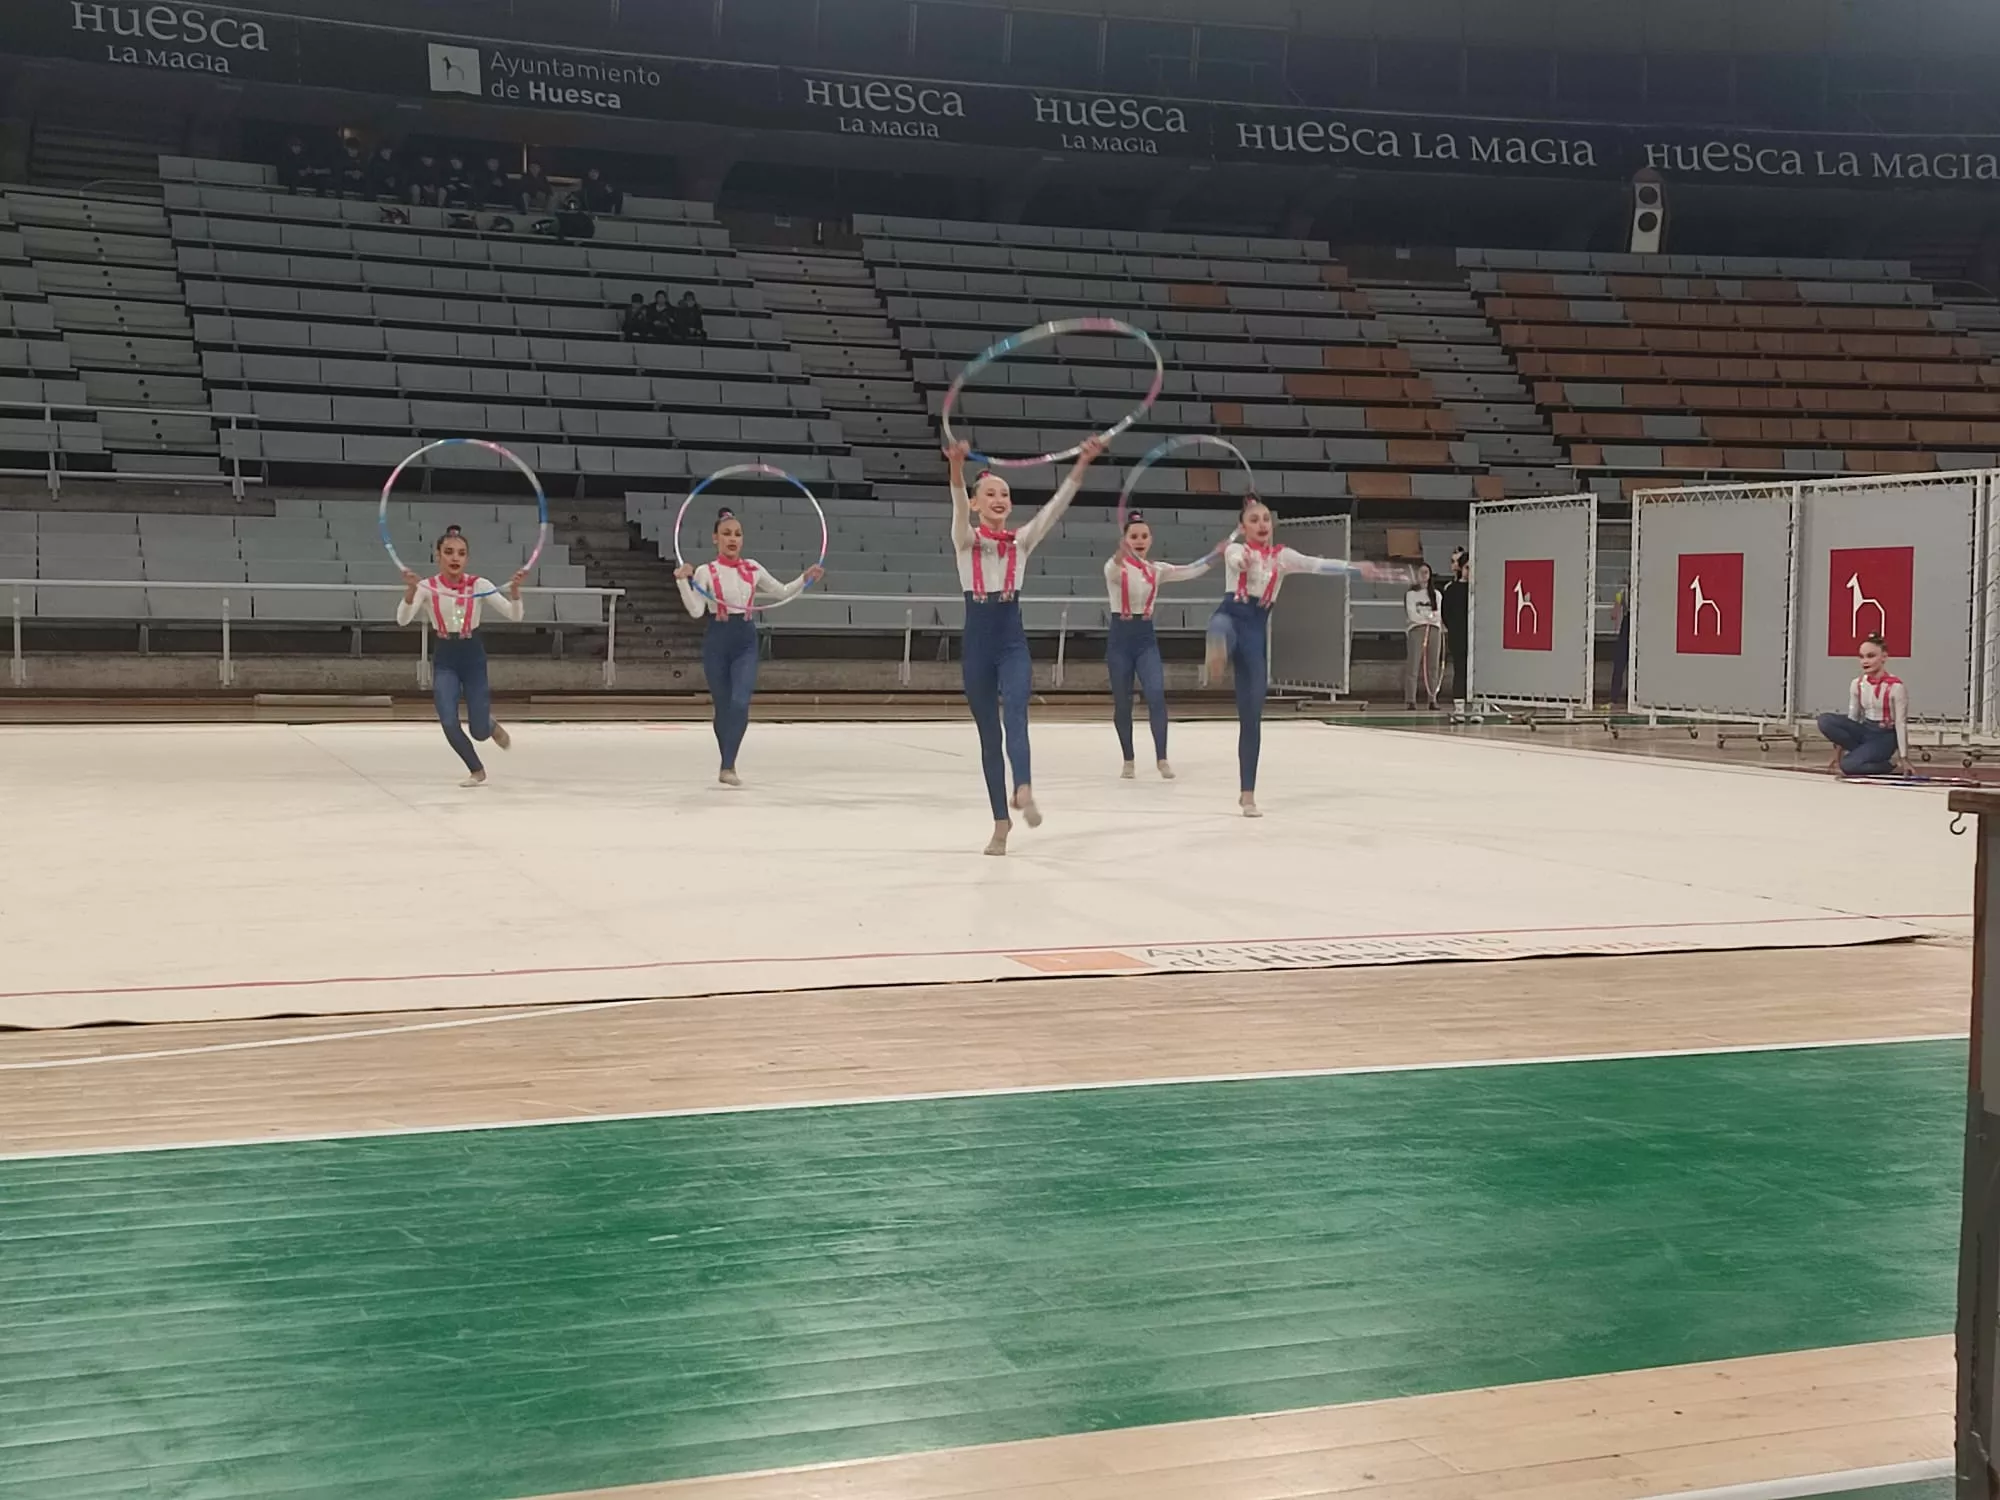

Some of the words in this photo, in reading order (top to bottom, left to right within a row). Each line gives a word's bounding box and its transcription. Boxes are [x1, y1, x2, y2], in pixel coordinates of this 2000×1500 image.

[71, 1, 269, 51] Huesca
[106, 44, 138, 64] La
[490, 51, 660, 86] Ayuntamiento
[490, 80, 520, 98] de
[528, 80, 621, 109] Huesca
[804, 78, 966, 117] Huesca
[839, 116, 866, 133] La
[1033, 96, 1188, 133] Huesca
[1061, 133, 1087, 150] La
[1236, 120, 1401, 157] Huesca
[1411, 131, 1460, 160] La
[1643, 140, 1805, 176] Huesca
[1813, 150, 1863, 177] La
[1245, 950, 1458, 965] Huesca
